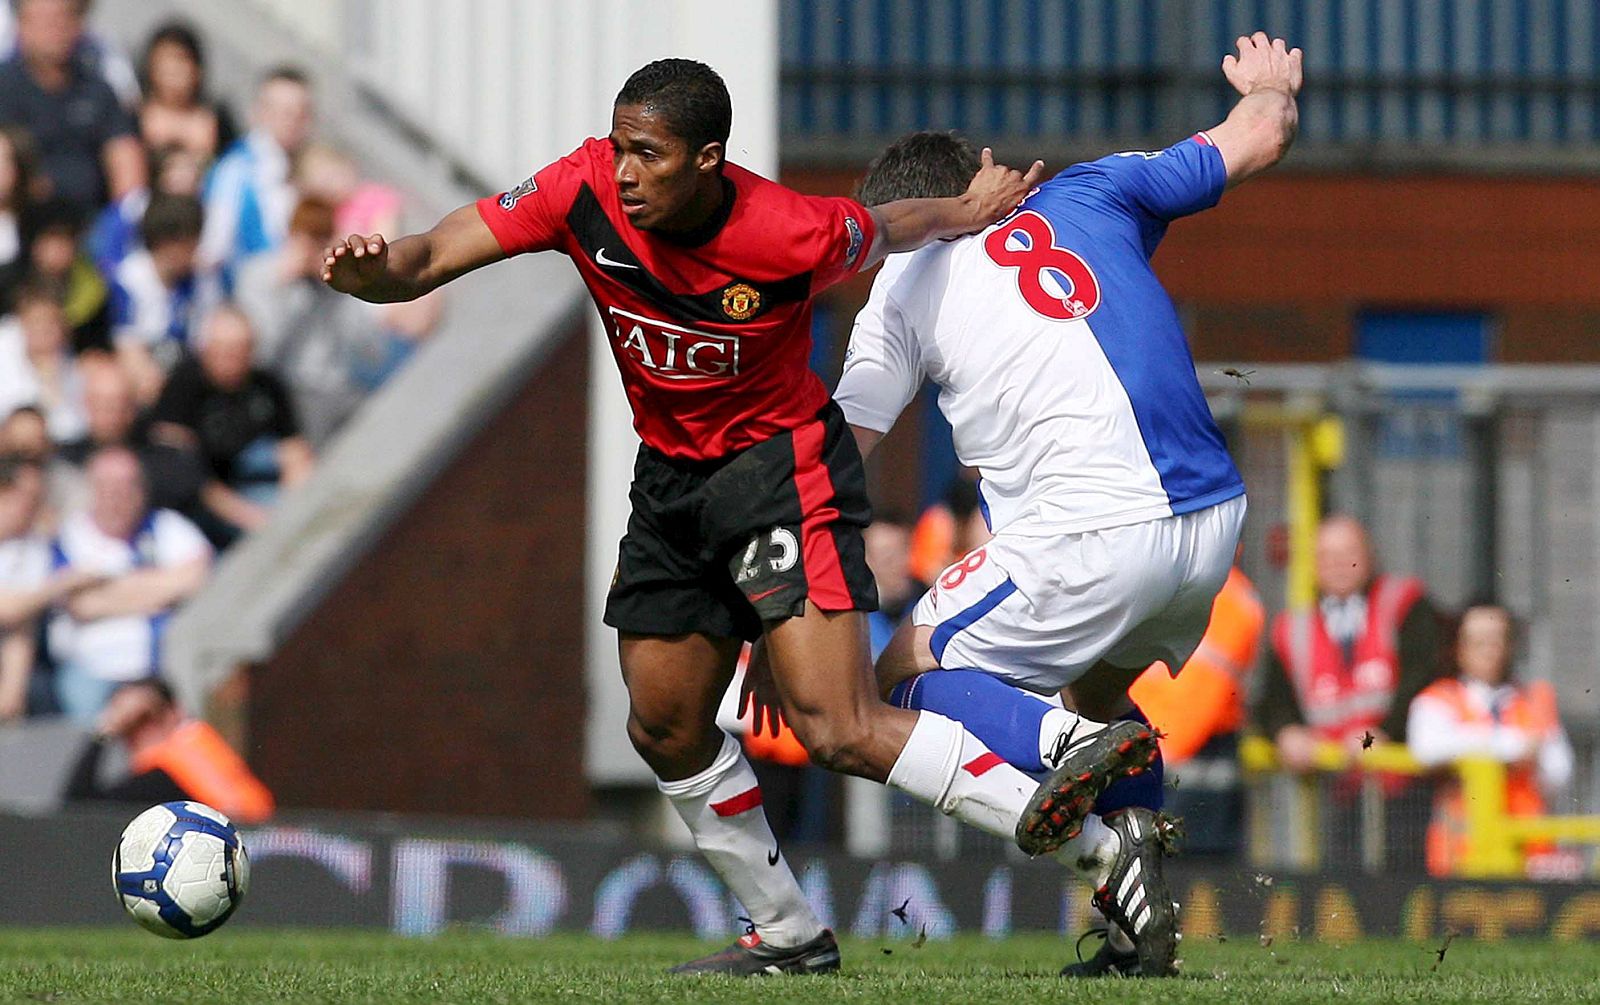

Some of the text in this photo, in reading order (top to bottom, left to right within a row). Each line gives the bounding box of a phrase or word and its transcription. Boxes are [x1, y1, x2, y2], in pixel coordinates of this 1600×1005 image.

[983, 210, 1101, 322] 8
[621, 323, 730, 376] AIG
[940, 548, 987, 590] 8
